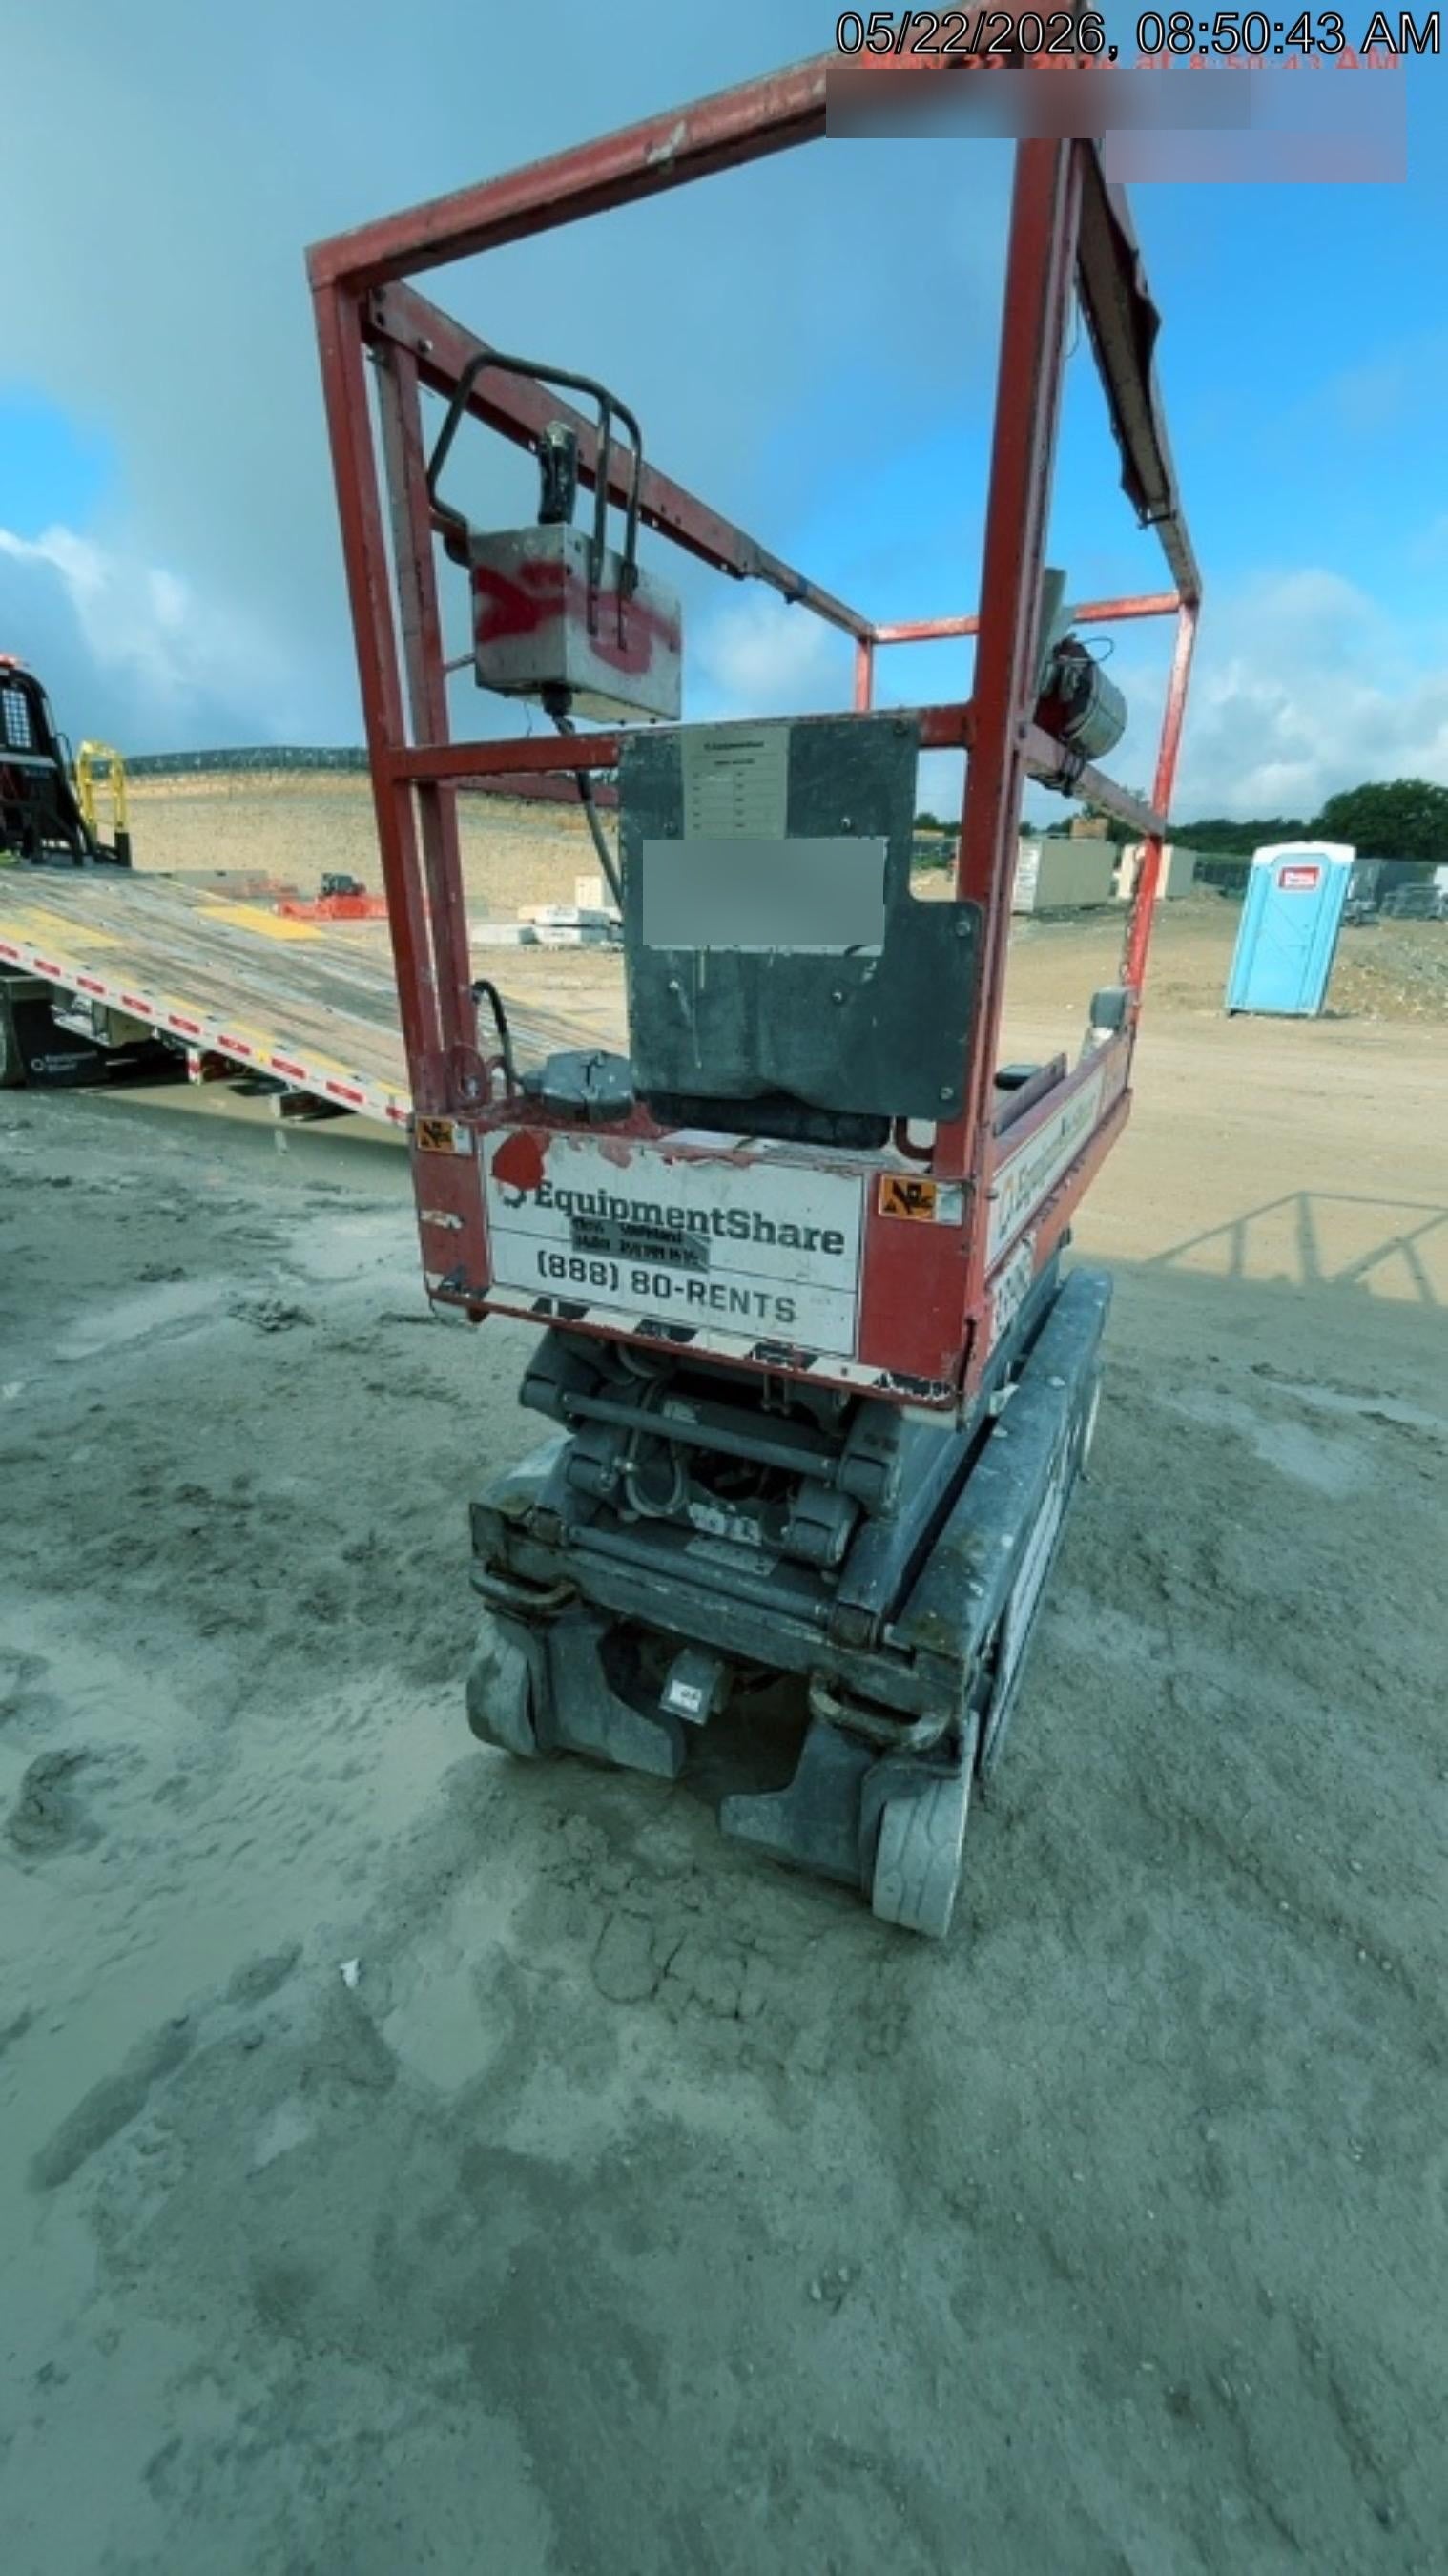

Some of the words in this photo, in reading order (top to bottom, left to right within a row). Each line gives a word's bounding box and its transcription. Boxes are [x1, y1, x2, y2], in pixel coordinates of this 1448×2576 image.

[534, 1180, 845, 1256] EquipmentShare
[537, 1249, 619, 1291] (888)
[631, 1269, 796, 1323] 80-RENTS
